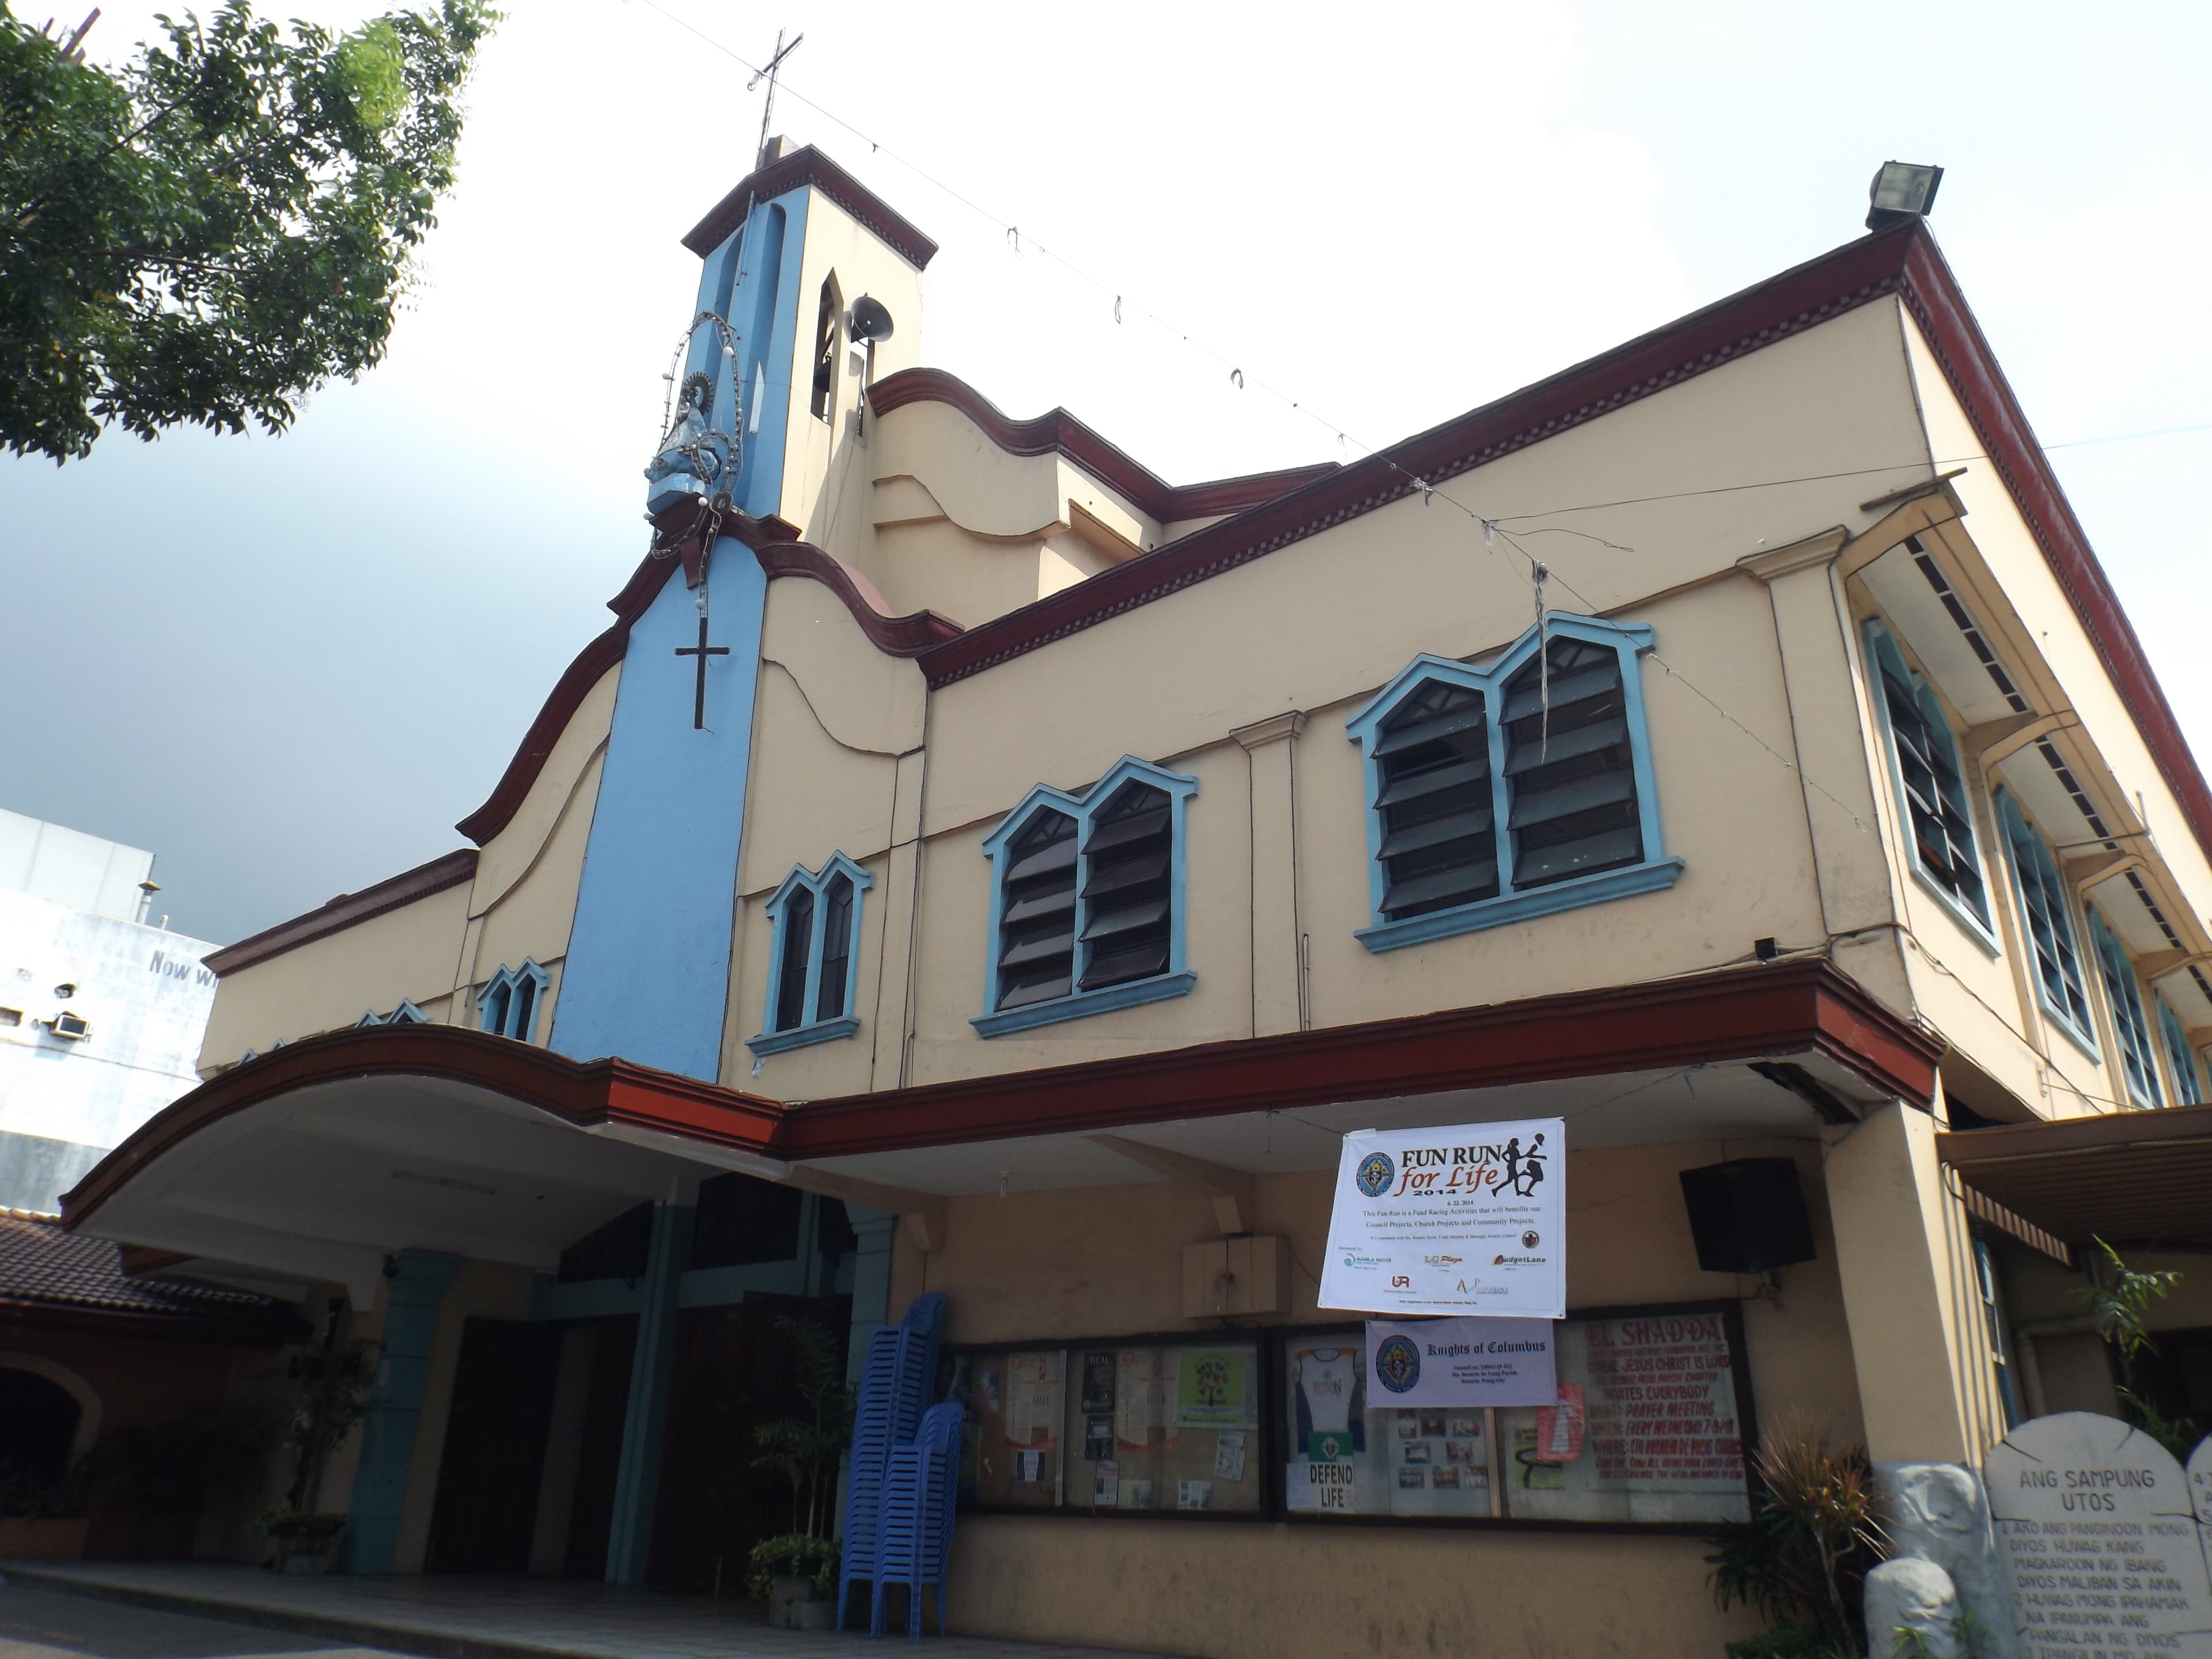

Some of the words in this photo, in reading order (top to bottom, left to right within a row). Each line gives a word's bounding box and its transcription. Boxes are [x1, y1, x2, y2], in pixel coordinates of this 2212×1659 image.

[1402, 1148, 1448, 1168] FUN
[1452, 1145, 1502, 1164] RUN
[1392, 1166, 1440, 1197] for
[1445, 1162, 1498, 1194] Life
[1437, 1219, 1460, 1228] Projects
[1473, 1218, 1508, 1226] Community
[1427, 1343, 1471, 1357] Knights
[1474, 1342, 1484, 1354] of
[1488, 1340, 1546, 1354] Columbus
[1622, 1358, 1654, 1373] JESUS
[1656, 1355, 1691, 1371] CHRIST
[1694, 1355, 1704, 1369] IS
[1604, 1387, 1643, 1400] INVITES
[1646, 1385, 1709, 1400] EVERYBODY
[1626, 1402, 1664, 1418] PRAYER
[1667, 1400, 1715, 1417] MEETING
[1626, 1420, 1654, 1435] EVERY
[1310, 1464, 1353, 1484] DEFEND
[2020, 1470, 2058, 1488] ANG
[2064, 1469, 2155, 1488] SAMPUNG
[1321, 1487, 1344, 1508] LIFE
[2061, 1493, 2115, 1512] UTOS
[2014, 1522, 2039, 1535] AKO
[2042, 1522, 2066, 1535] ANG
[2147, 1522, 2190, 1537] MONG
[2010, 1539, 2047, 1553] DIYOS
[2053, 1539, 2100, 1554] HUWAG
[2105, 1540, 2145, 1554] KANG
[2099, 1558, 2118, 1571] NG
[2124, 1558, 2166, 1573] IBANG
[2018, 1575, 2056, 1588] DIYOS
[2059, 1575, 2119, 1590] MALIBAN
[2122, 1577, 2143, 1590] SA
[2149, 1577, 2181, 1592] AKIN
[2077, 1594, 2116, 1608] MONG
[2025, 1611, 2044, 1624] NA
[2120, 1613, 2149, 1628] ANG
[2108, 1631, 2128, 1646] NG
[2135, 1633, 2181, 1648] DIYOS
